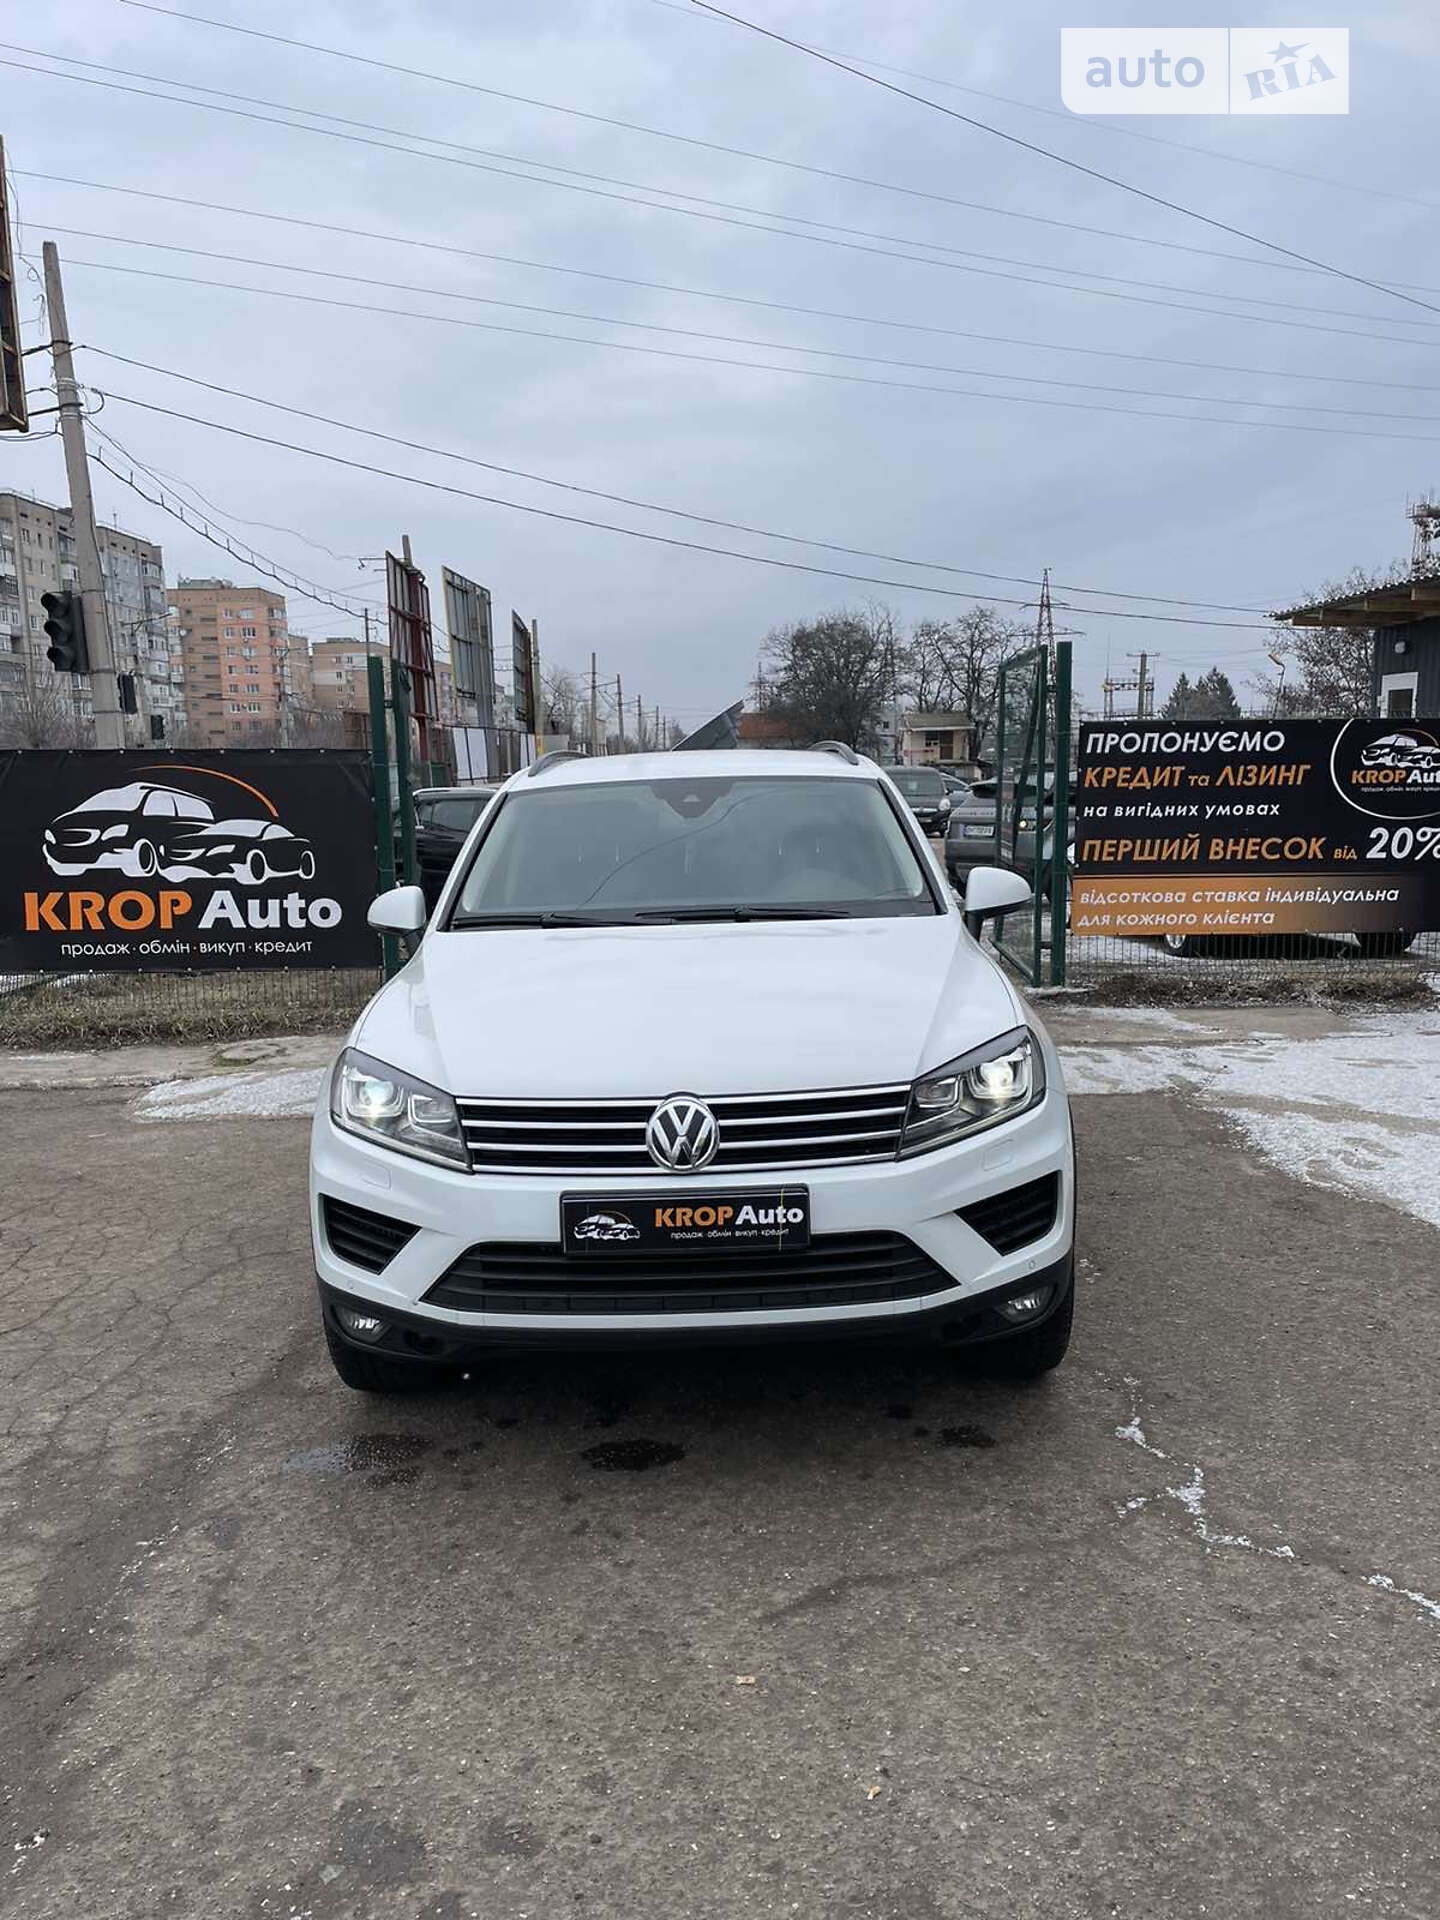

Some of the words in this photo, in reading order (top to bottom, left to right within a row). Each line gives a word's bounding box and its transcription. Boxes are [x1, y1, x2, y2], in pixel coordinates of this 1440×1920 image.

[1086, 731, 1286, 754] ПРОПОНУЄМО
[1083, 767, 1185, 790] КРЕДИТ
[1188, 774, 1210, 787] та
[1215, 764, 1312, 787] ЛІЗИНГ
[1351, 769, 1407, 784] KROP
[1084, 806, 1108, 817] на
[1114, 804, 1199, 818] вигідних
[1205, 803, 1280, 819] умовах
[1082, 833, 1201, 862] ПЕРШИЙ
[1208, 836, 1326, 861] ВНЕСОК
[1333, 845, 1358, 860] від
[1366, 827, 1440, 861] 20%
[1079, 890, 1186, 905] відсоткова
[1193, 890, 1260, 903] ставка
[1265, 887, 1399, 905] індивідуальна
[23, 890, 193, 931] KROP
[198, 890, 343, 930] Auto
[1077, 915, 1110, 928] для
[1116, 912, 1197, 926] кожного
[1203, 911, 1275, 925] клієнта
[61, 942, 130, 958] продаж
[139, 940, 191, 954] обмін
[199, 941, 246, 956] викуп
[255, 940, 313, 956] кредит
[655, 1206, 734, 1228] KROP
[735, 1205, 804, 1225] Auto
